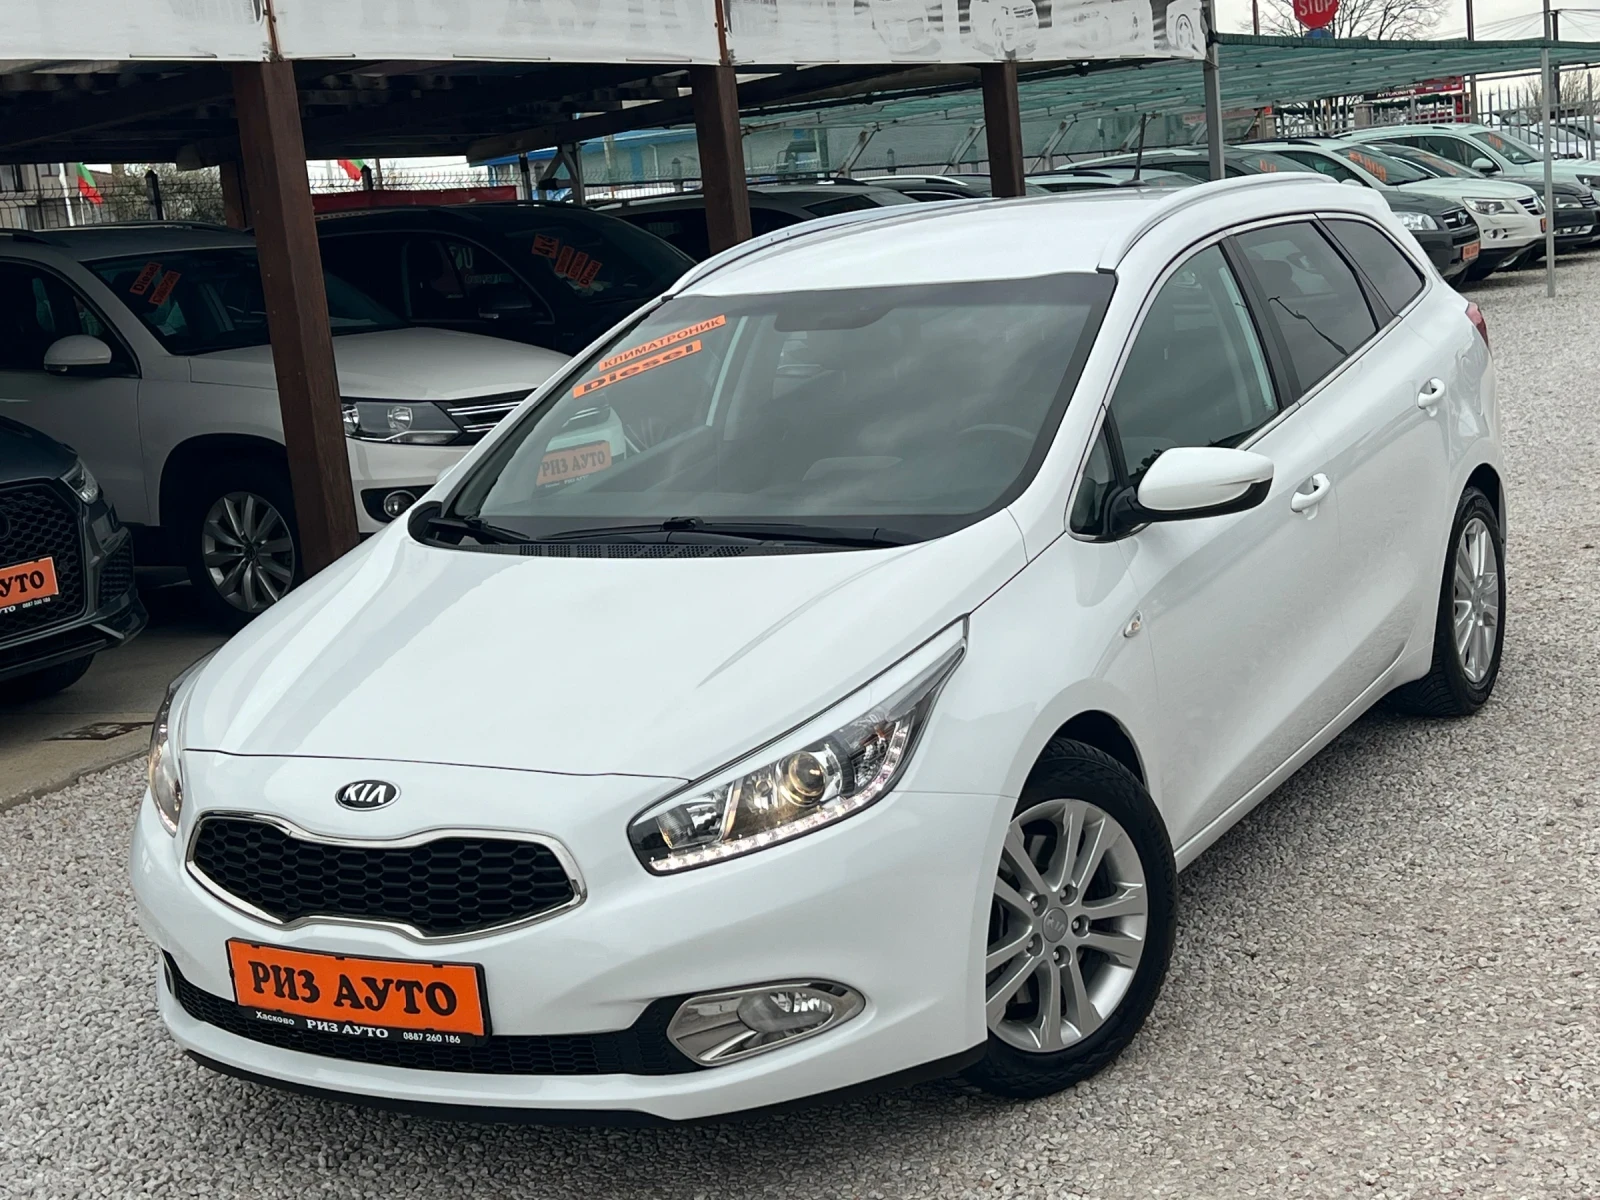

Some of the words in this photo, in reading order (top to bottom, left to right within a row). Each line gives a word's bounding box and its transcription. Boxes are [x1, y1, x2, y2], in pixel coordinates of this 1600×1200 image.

[1299, 0, 1332, 16] STOP
[603, 317, 721, 368] КЛИМАТРОНИК
[583, 344, 694, 392] Diesel
[572, 450, 606, 472] АУТО
[341, 783, 387, 803] KIA
[248, 960, 321, 1004] РИЗ
[333, 974, 458, 1017] АУТО
[255, 1010, 295, 1026] Хасково
[306, 1019, 339, 1033] РИЗ
[342, 1024, 389, 1038] АУТО
[403, 1031, 424, 1041] 0887
[425, 1033, 442, 1042] 260
[445, 1034, 461, 1044] 186
